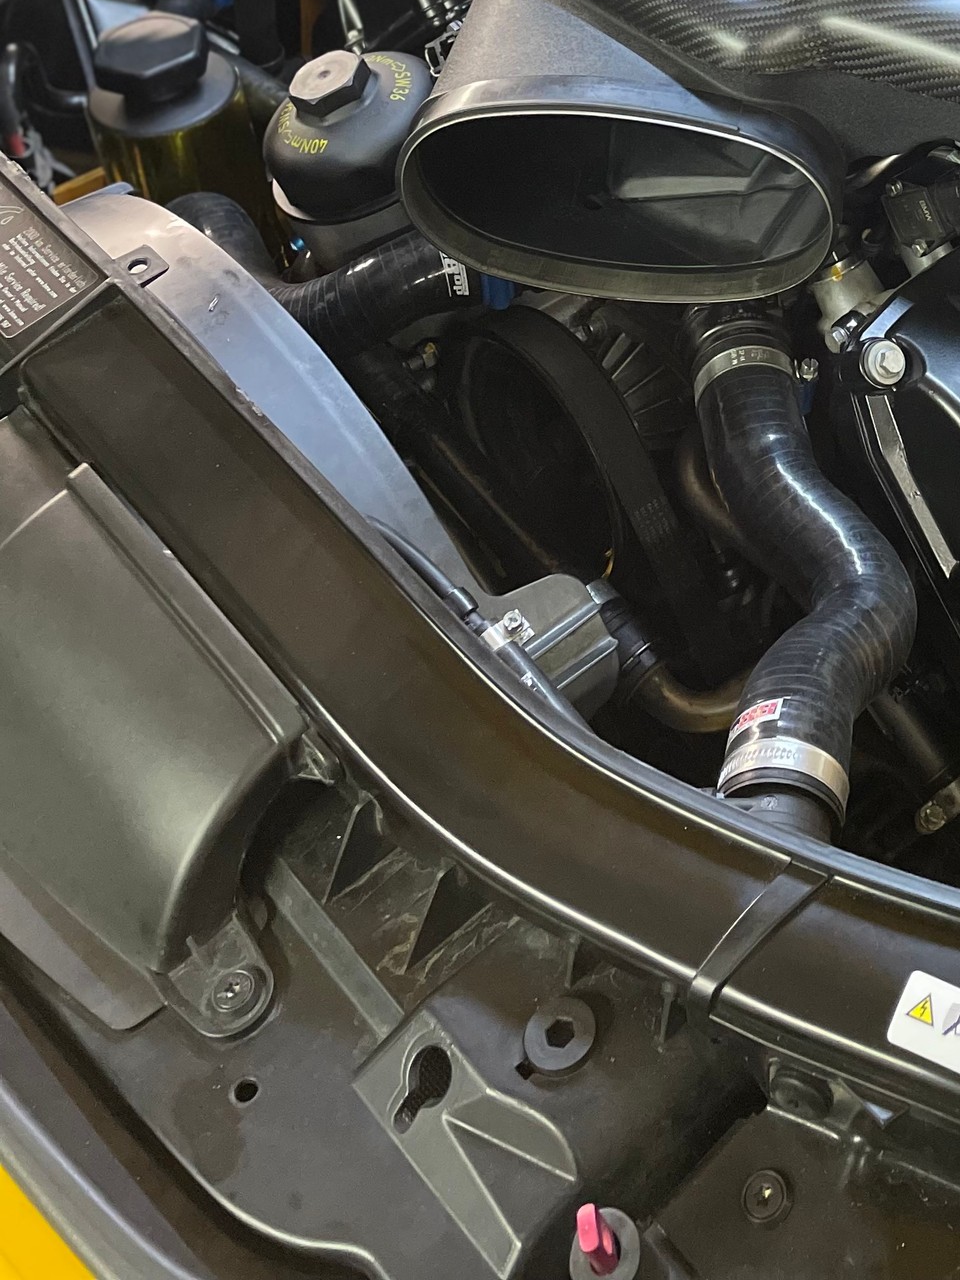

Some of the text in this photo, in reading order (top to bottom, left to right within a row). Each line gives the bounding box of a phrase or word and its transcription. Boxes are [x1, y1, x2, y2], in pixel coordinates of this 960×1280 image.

[390, 71, 412, 101] SW36
[291, 135, 328, 154] 40Nm
[4, 272, 23, 291] Service
